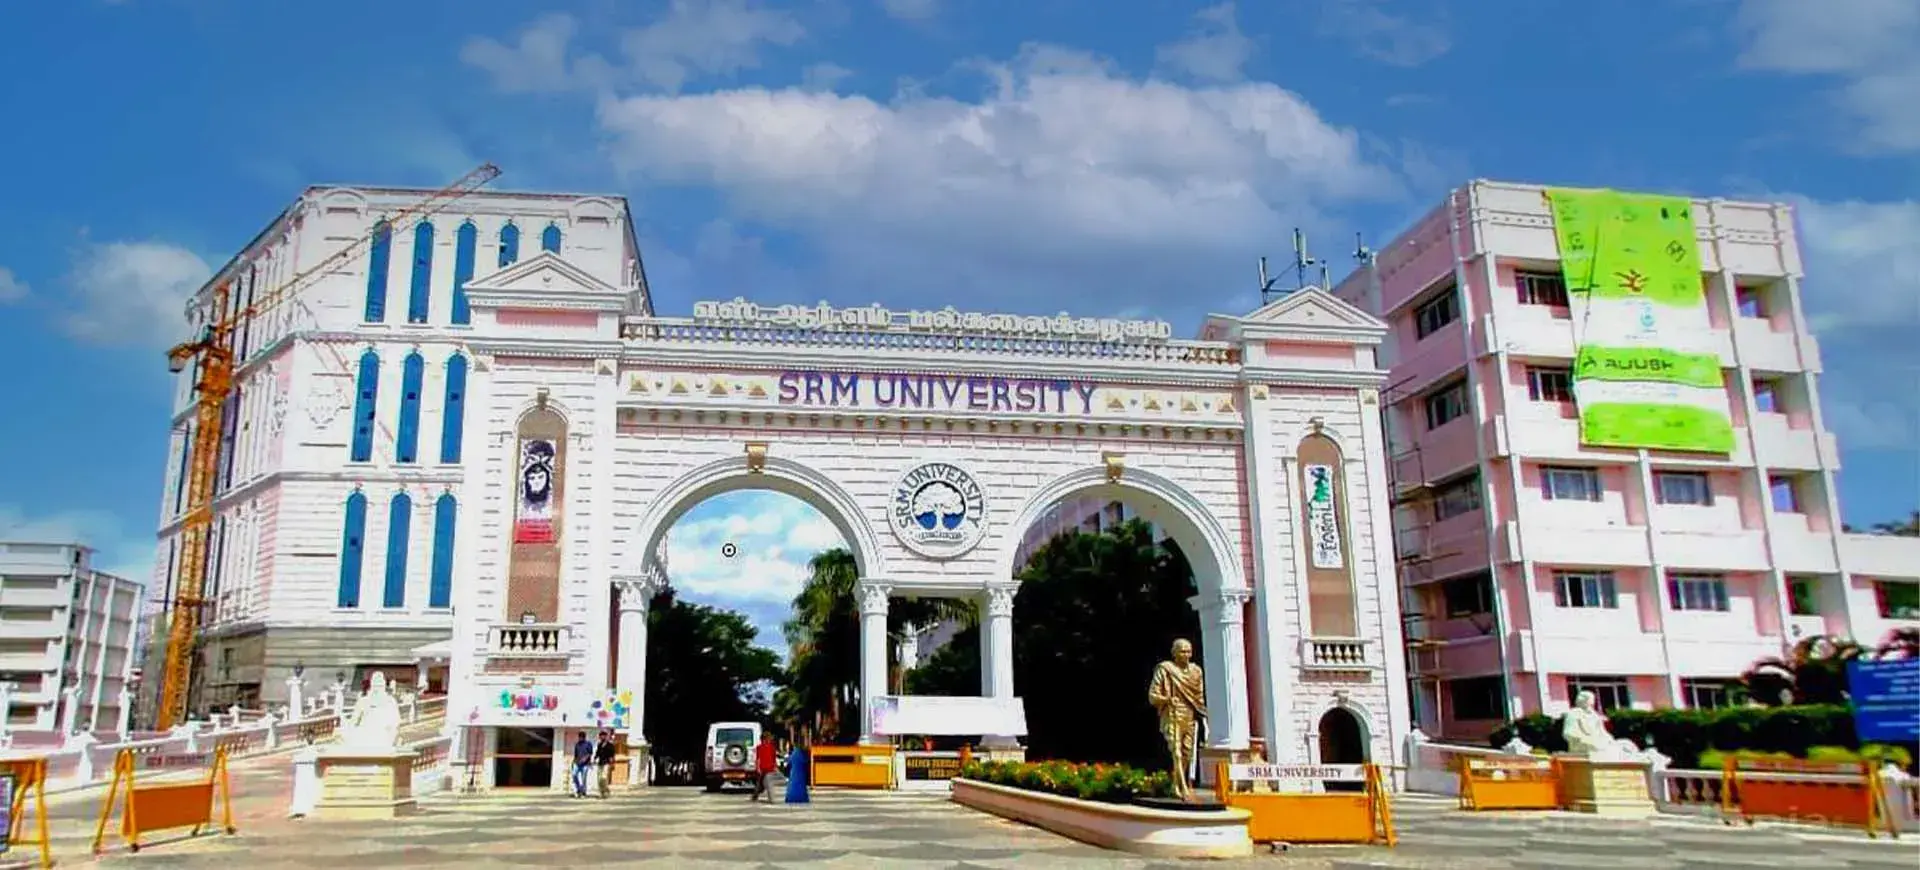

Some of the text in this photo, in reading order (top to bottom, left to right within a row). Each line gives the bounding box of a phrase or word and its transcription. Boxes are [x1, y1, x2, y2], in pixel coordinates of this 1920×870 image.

[778, 370, 1099, 414] SRM UNIVERSITY
[896, 463, 984, 529] SRM UNIVERSITY
[1248, 766, 1343, 779] SRM UNIVERSITY
